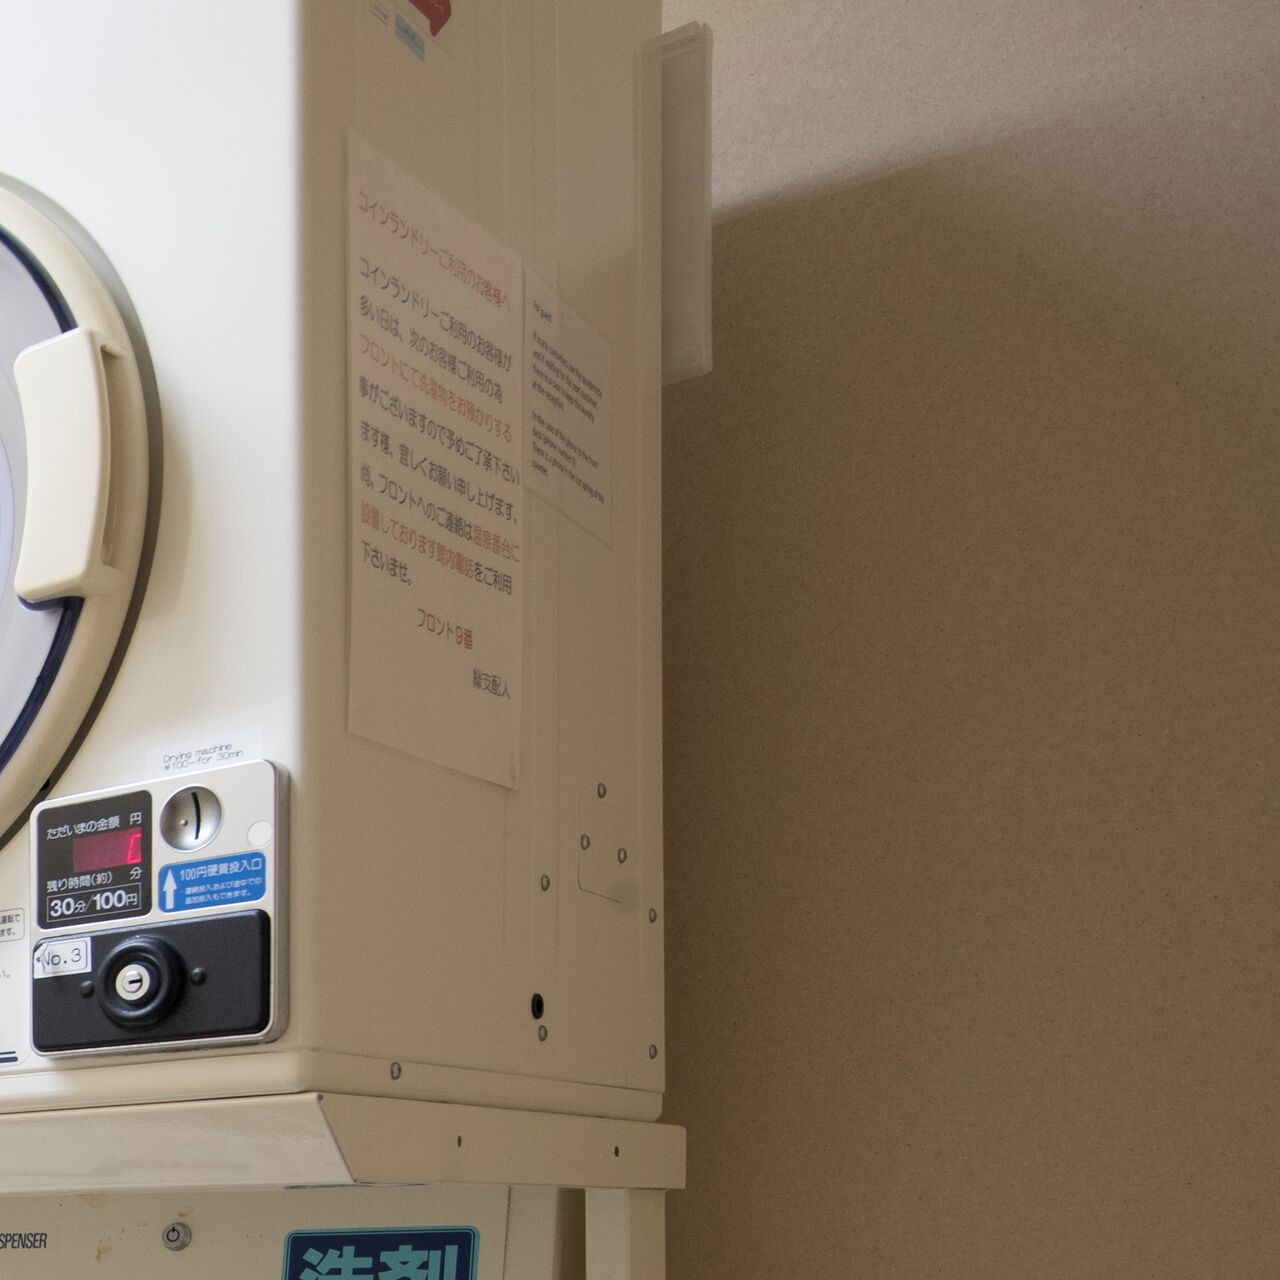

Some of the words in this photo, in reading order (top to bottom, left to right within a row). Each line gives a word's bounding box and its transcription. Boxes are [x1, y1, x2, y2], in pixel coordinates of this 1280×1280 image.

[46, 815, 120, 840] ただいまの金額
